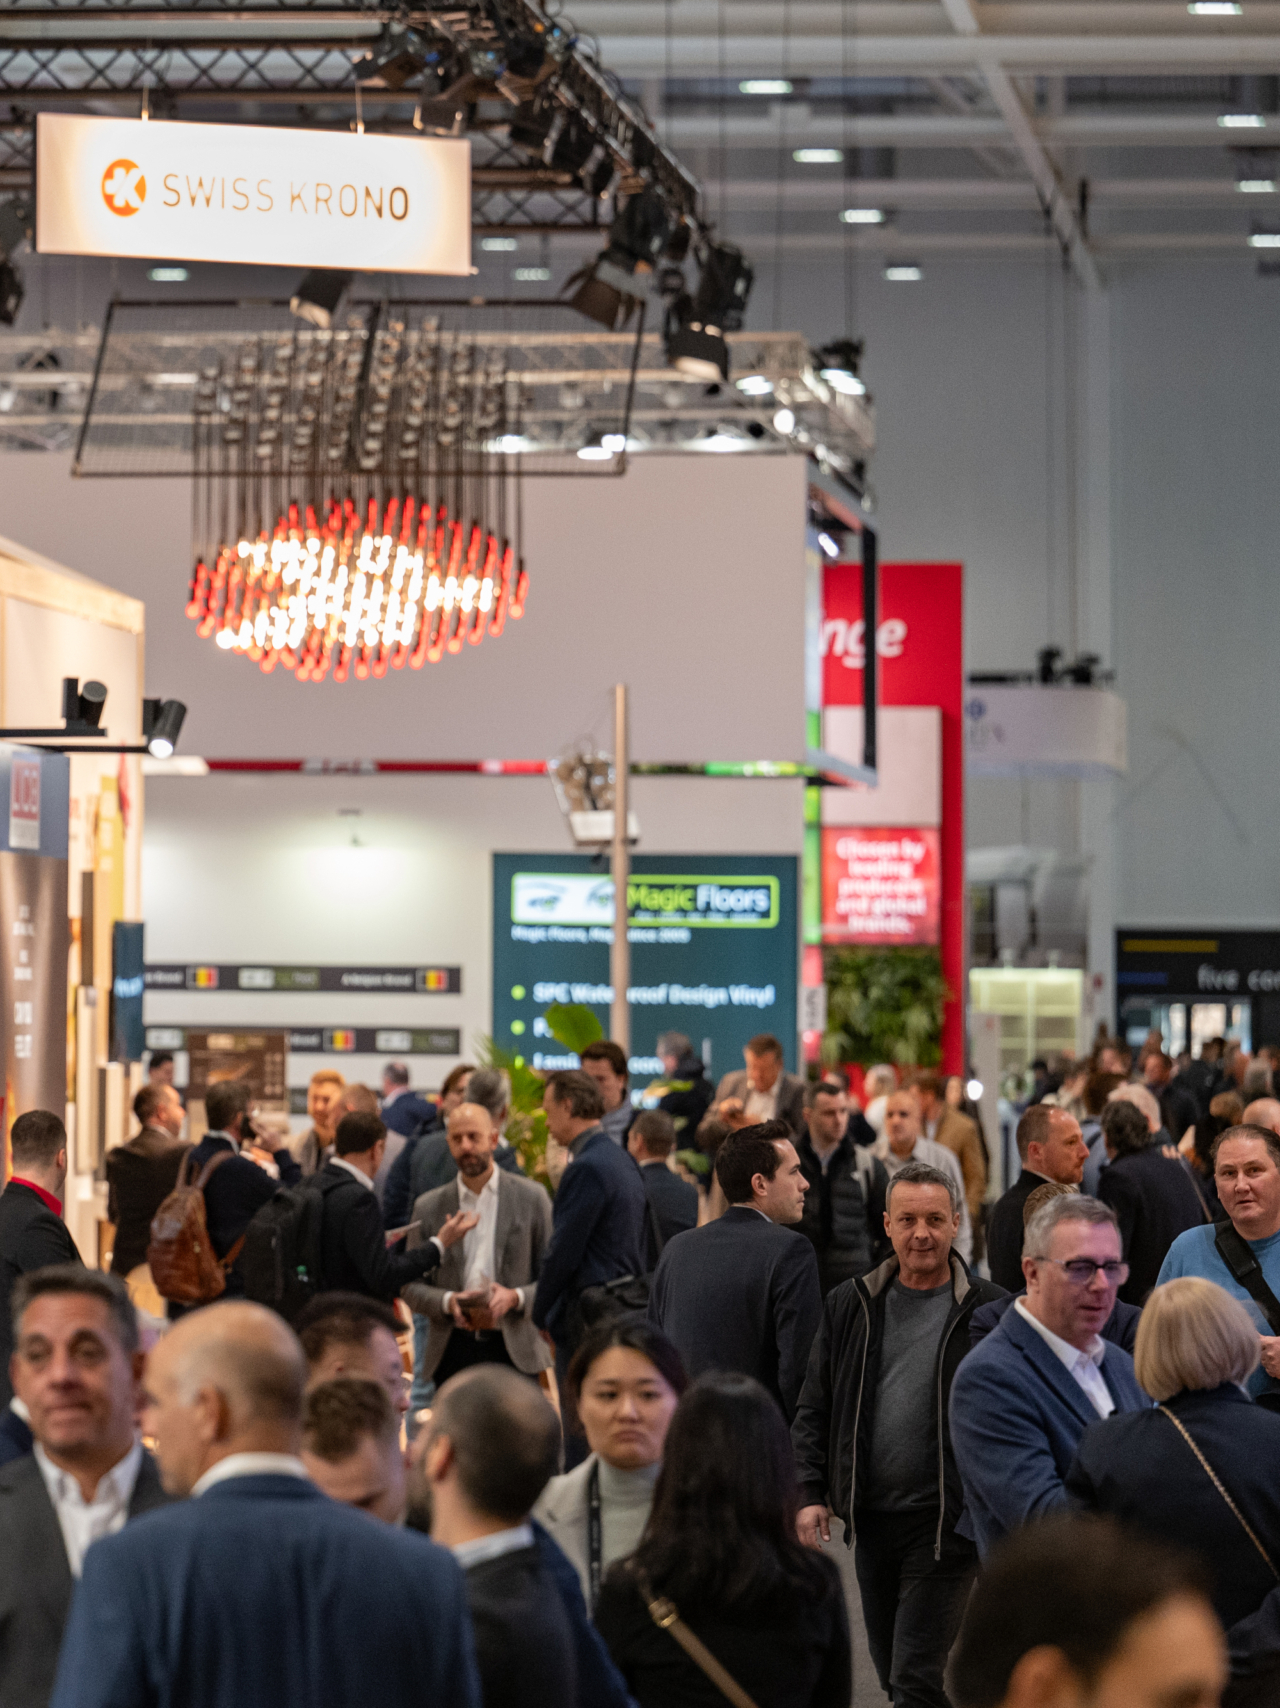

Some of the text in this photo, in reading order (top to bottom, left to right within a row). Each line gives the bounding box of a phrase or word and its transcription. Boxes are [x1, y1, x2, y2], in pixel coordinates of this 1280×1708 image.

[163, 173, 410, 221] SWISS KRONO
[819, 617, 908, 670] nge
[626, 884, 770, 914] Magic Floors
[669, 984, 728, 1008] Design
